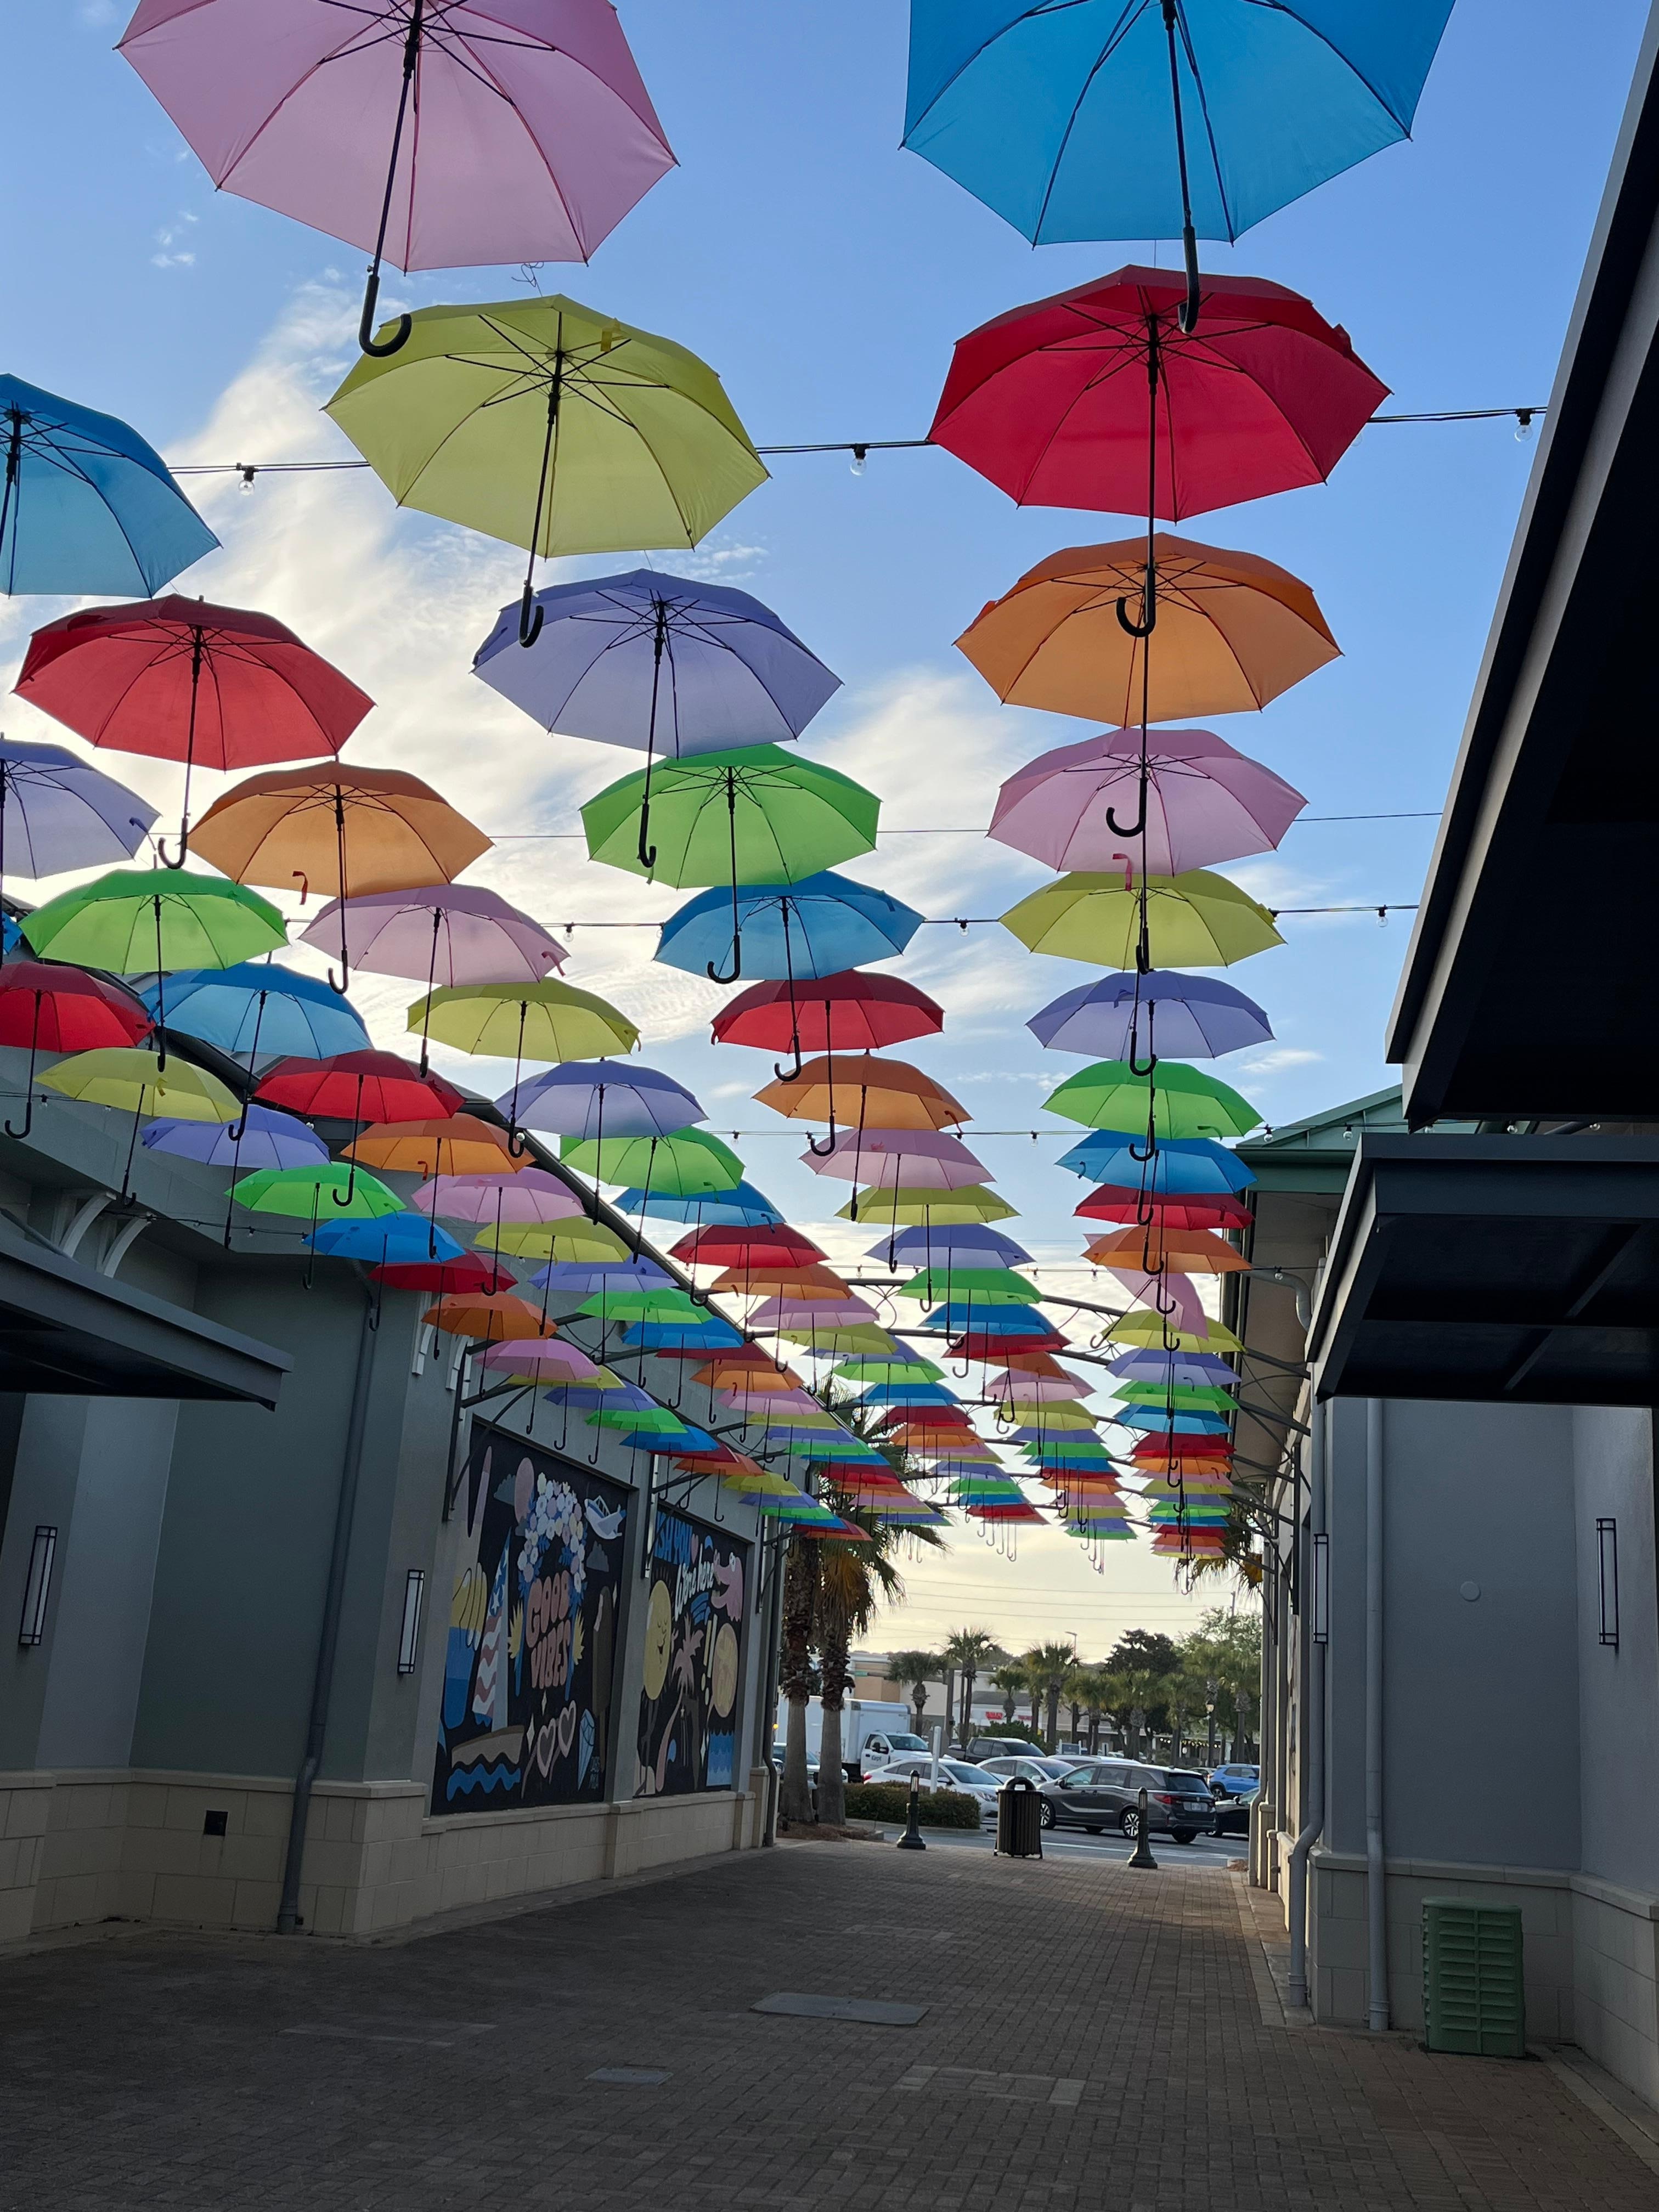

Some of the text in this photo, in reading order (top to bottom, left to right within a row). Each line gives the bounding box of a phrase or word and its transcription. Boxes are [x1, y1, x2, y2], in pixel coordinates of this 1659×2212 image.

[673, 1516, 693, 1567] YOU
[526, 1570, 569, 1648] GOOD
[531, 1620, 571, 1689] VIBES
